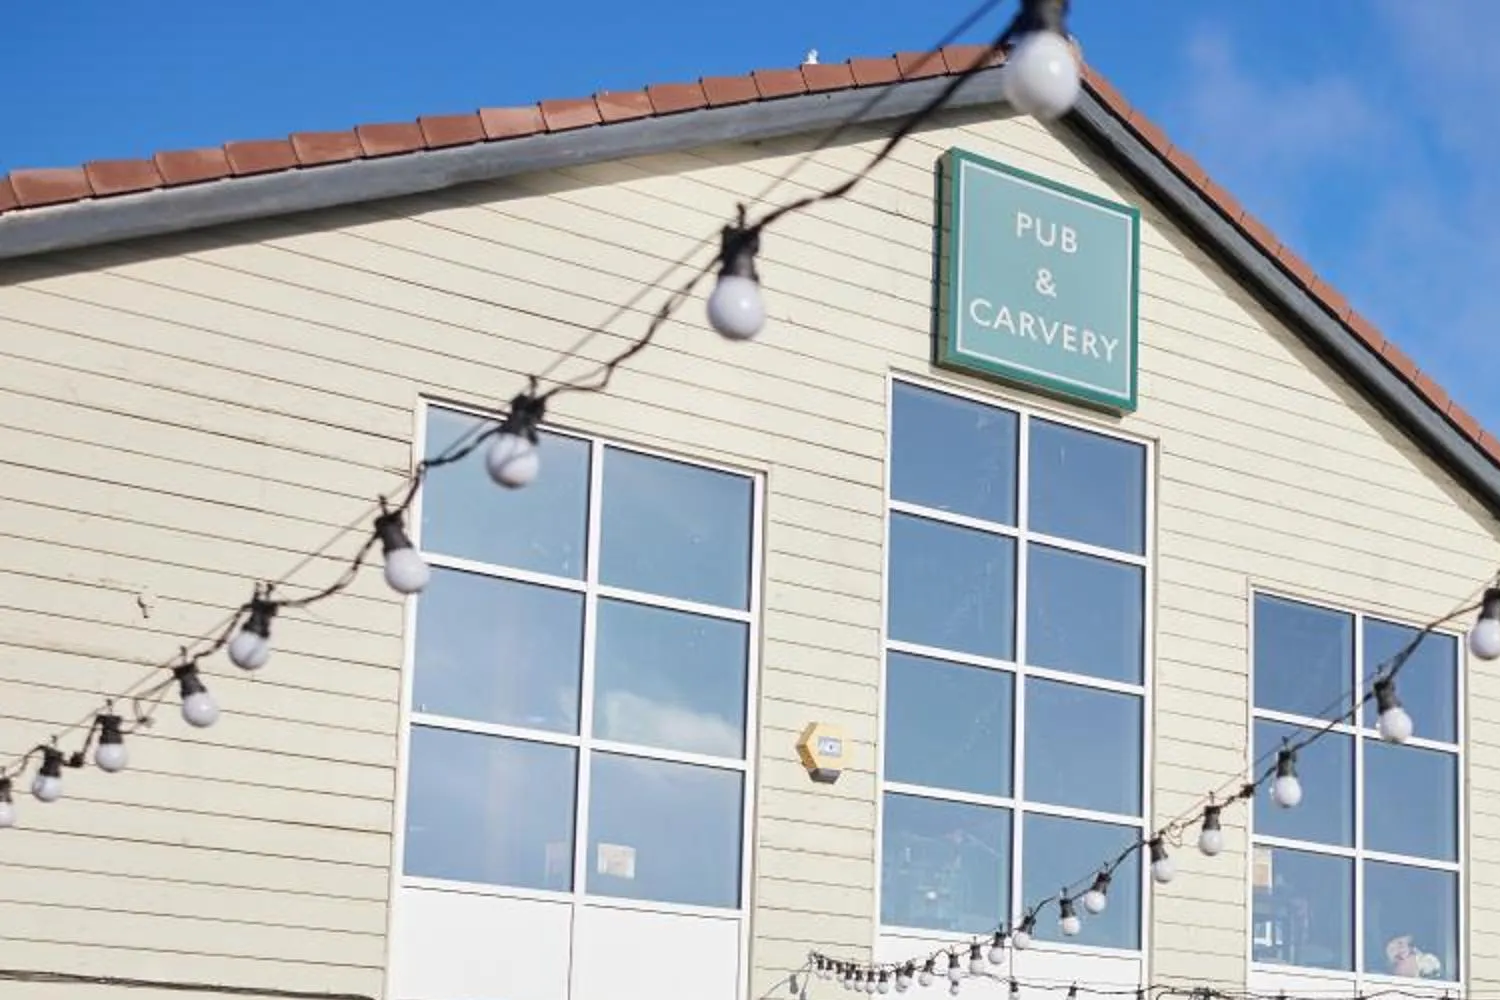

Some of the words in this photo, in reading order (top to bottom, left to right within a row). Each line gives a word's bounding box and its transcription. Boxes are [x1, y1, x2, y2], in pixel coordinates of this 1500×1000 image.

[1015, 211, 1078, 253] PUB
[1035, 268, 1057, 298] &
[969, 298, 1119, 363] CARVERY
